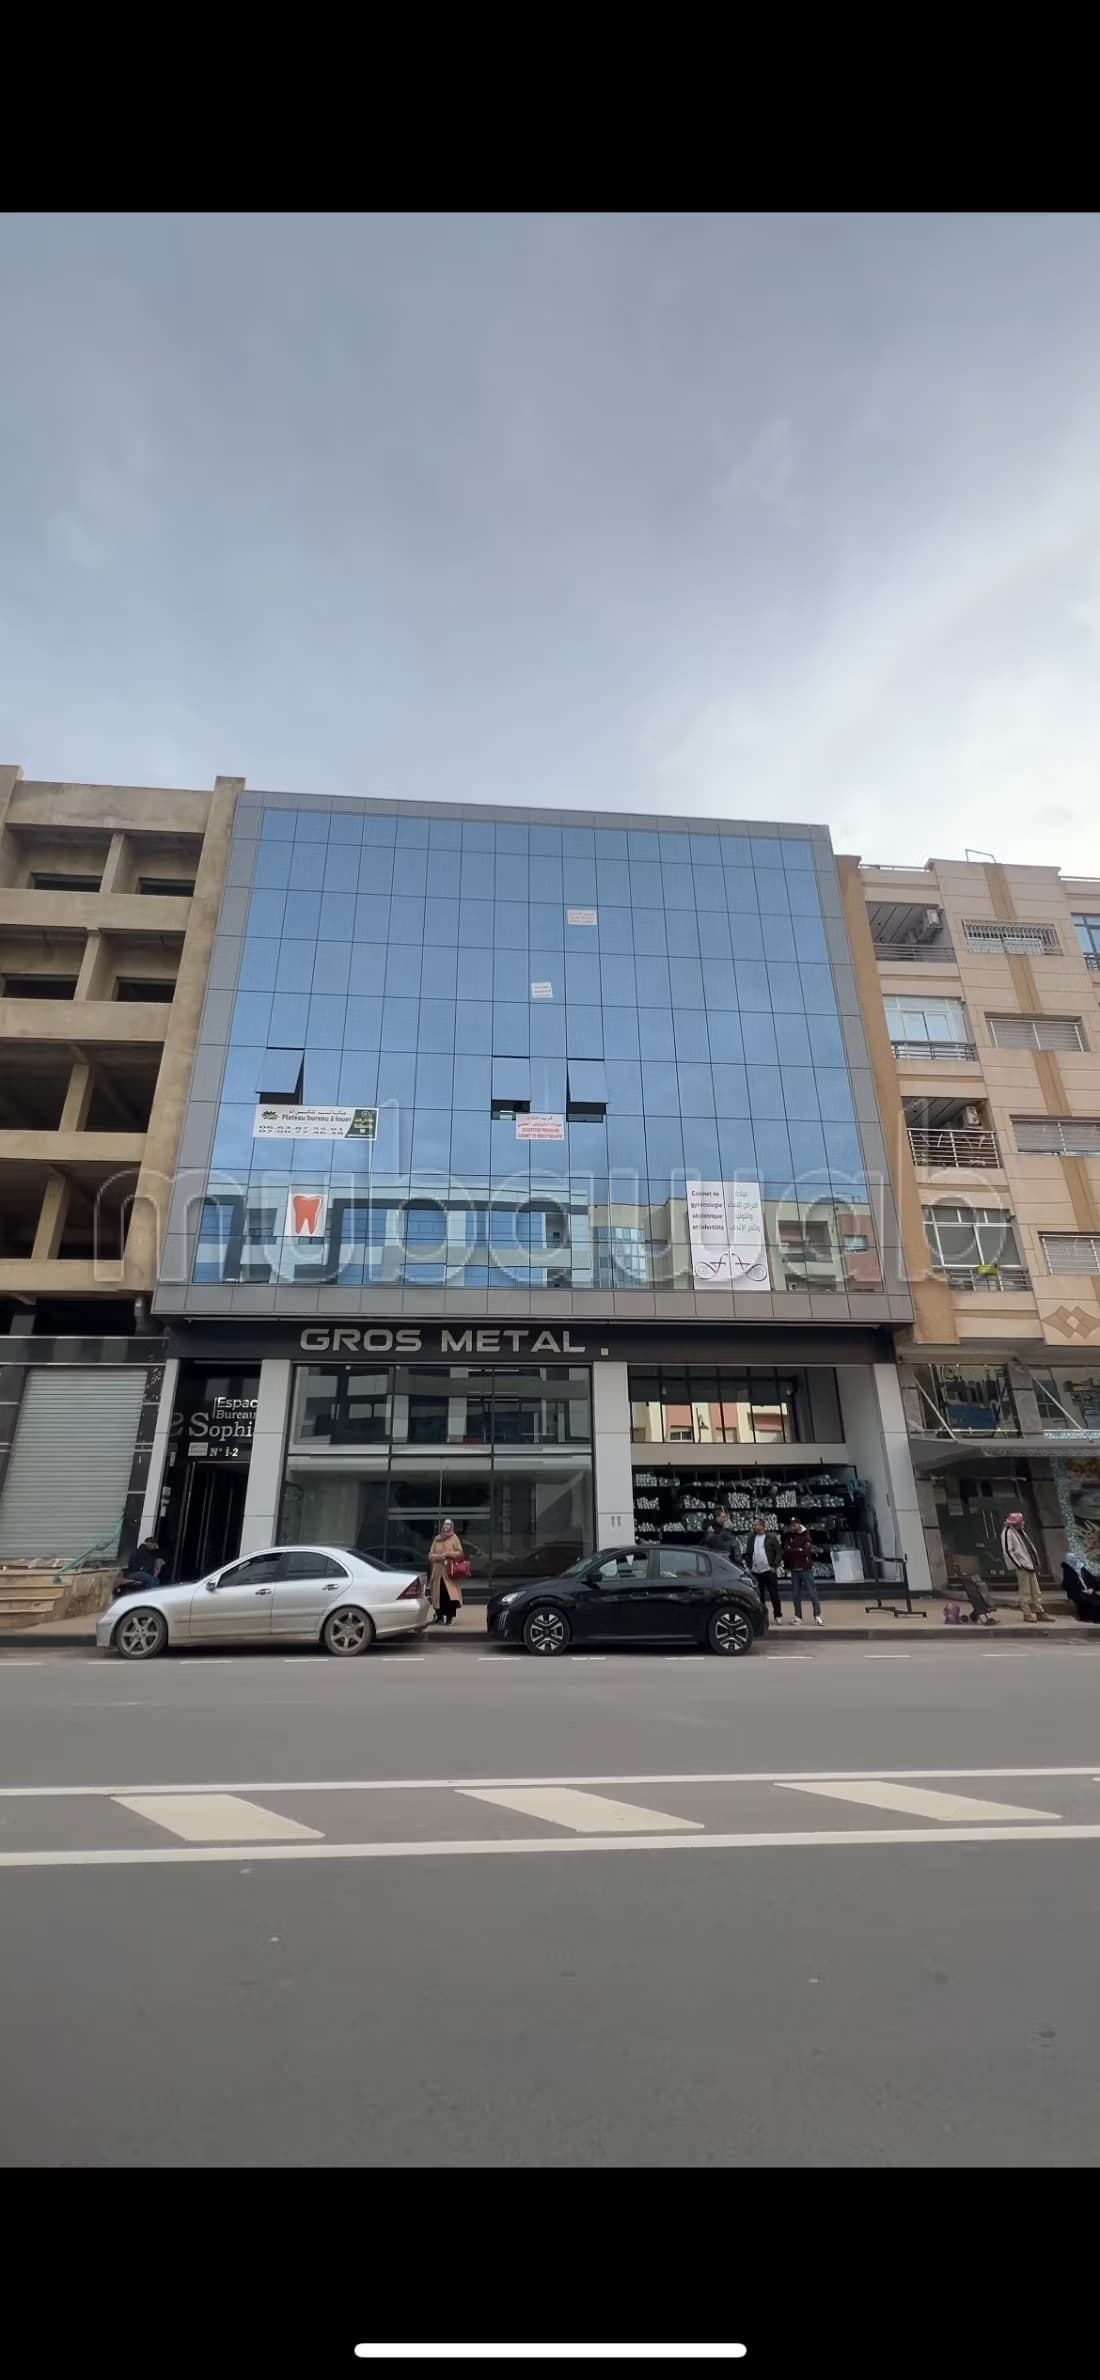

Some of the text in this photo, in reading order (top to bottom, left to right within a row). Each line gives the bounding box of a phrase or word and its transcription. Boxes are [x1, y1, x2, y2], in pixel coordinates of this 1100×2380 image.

[300, 1329, 586, 1353] GROS METAL
[216, 1396, 259, 1411] Espac
[189, 1411, 254, 1442] Sophi
